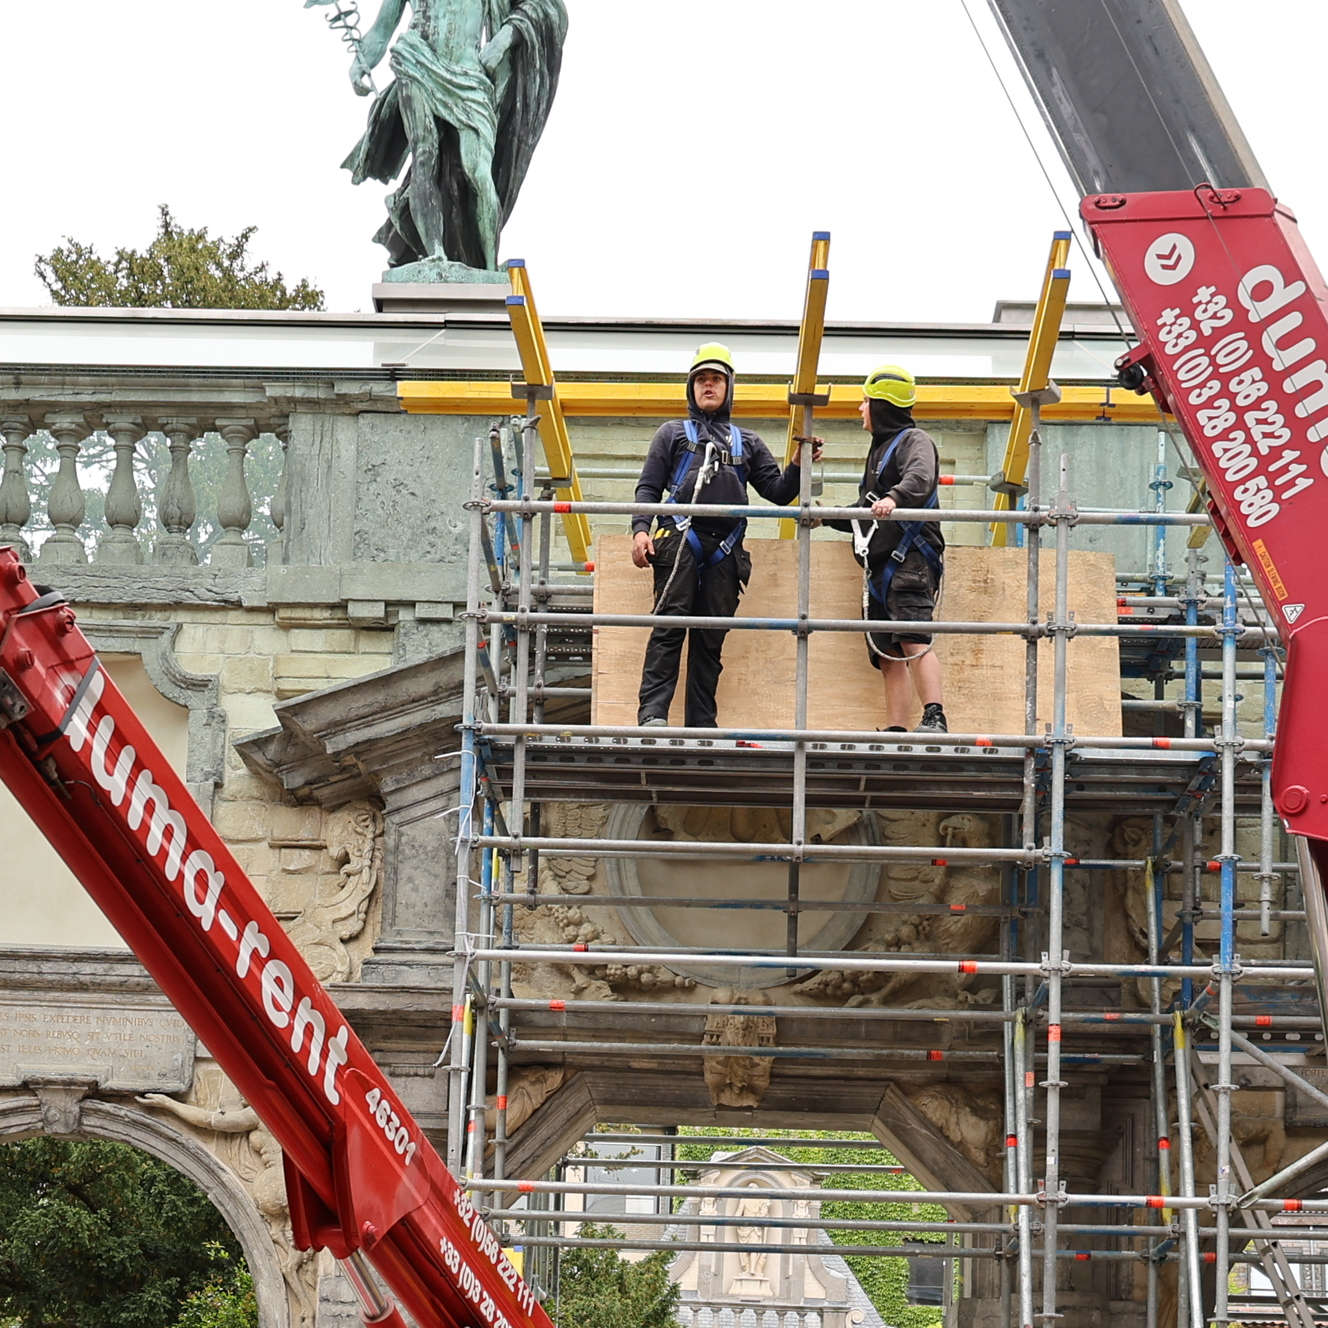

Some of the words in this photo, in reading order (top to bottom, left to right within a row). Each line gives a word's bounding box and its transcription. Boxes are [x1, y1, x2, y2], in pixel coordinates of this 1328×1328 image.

[1156, 308, 1197, 355] +33
[1192, 285, 1233, 336] +32
[1172, 348, 1213, 388] (0)
[1211, 332, 1253, 373] (0)
[1188, 379, 1221, 405] 3
[1229, 367, 1269, 407] 56
[1196, 398, 1236, 437] 28
[1243, 400, 1291, 455] 222
[1212, 430, 1258, 482] 200
[1268, 449, 1314, 499] 111
[1233, 475, 1280, 528] 580
[54, 669, 349, 1106] duma-rent
[365, 1087, 417, 1166] 46301
[439, 1236, 461, 1275] +33
[453, 1188, 474, 1227] +32
[497, 1253, 519, 1292] 222
[517, 1278, 536, 1317] 111
